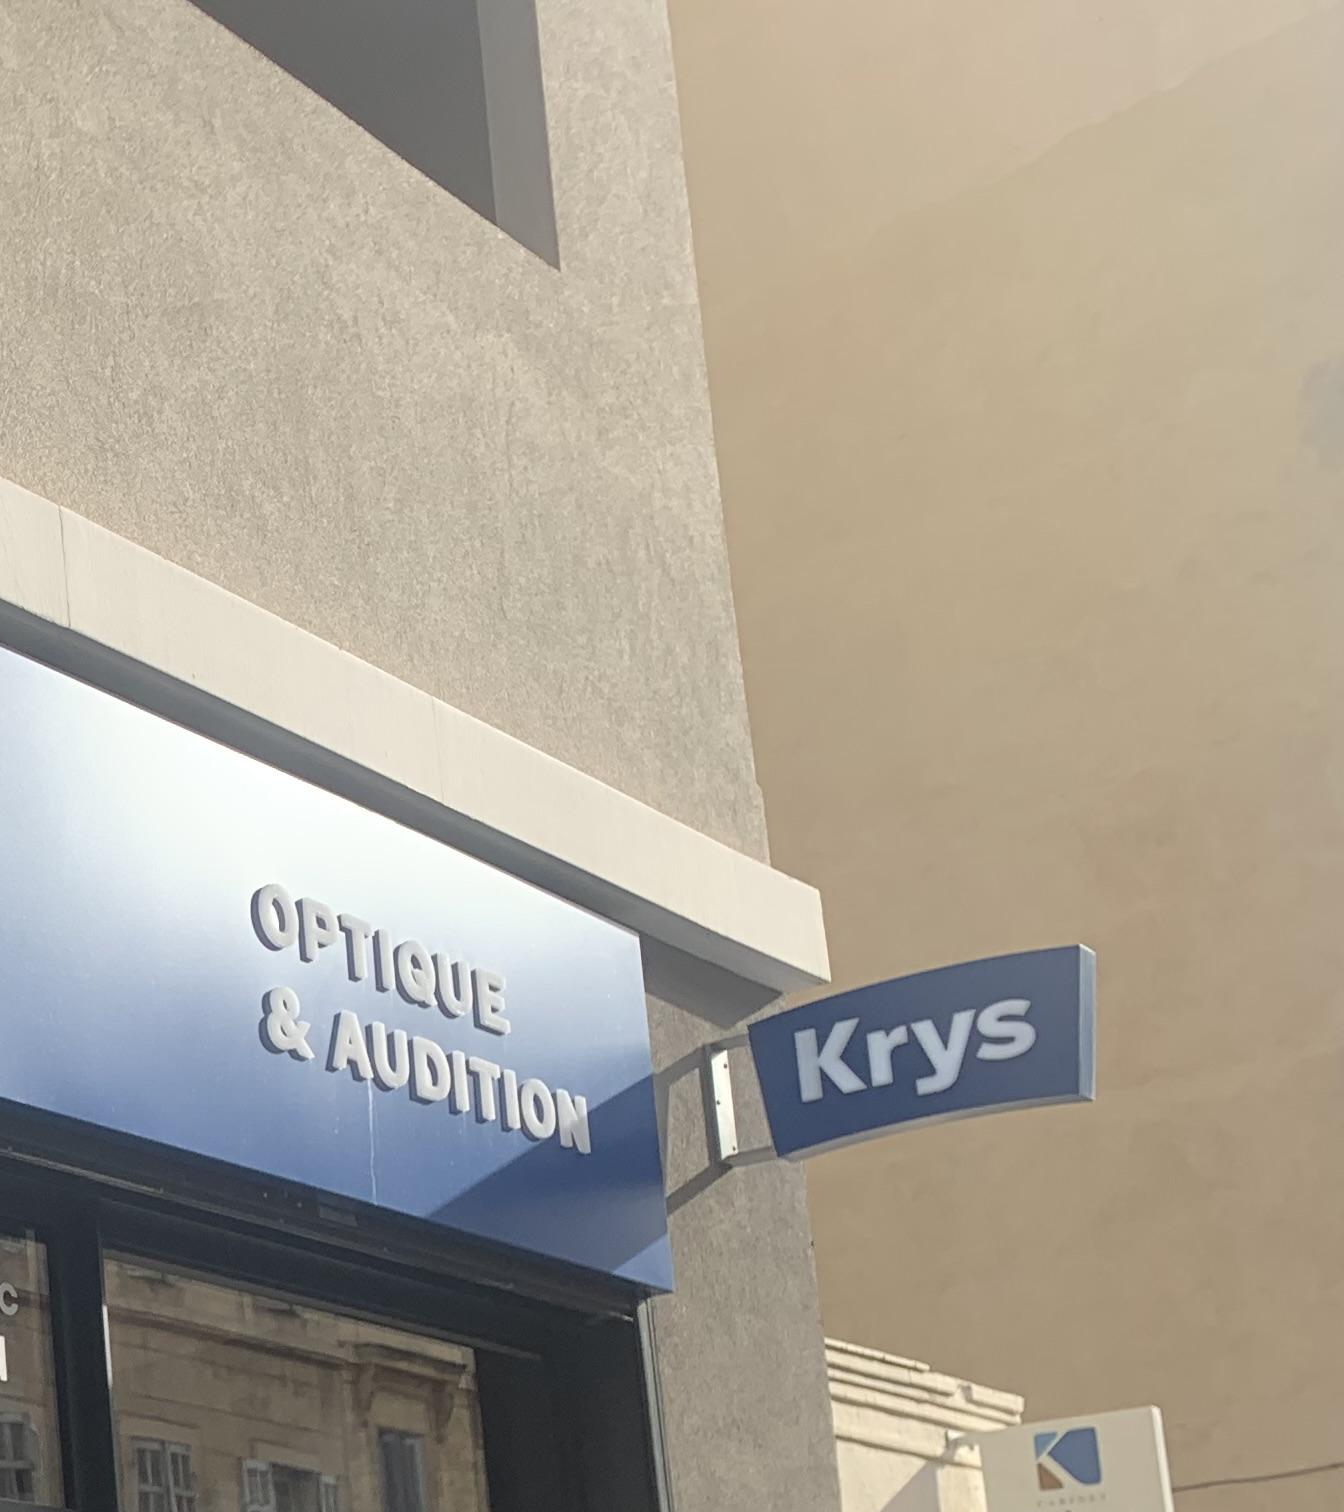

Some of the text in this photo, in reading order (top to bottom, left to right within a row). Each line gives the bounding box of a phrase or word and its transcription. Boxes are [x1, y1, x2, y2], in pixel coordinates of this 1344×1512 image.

[250, 883, 512, 1036] OPTIQUE
[258, 986, 592, 1155] & AUDITION
[793, 998, 1037, 1104] Krys
